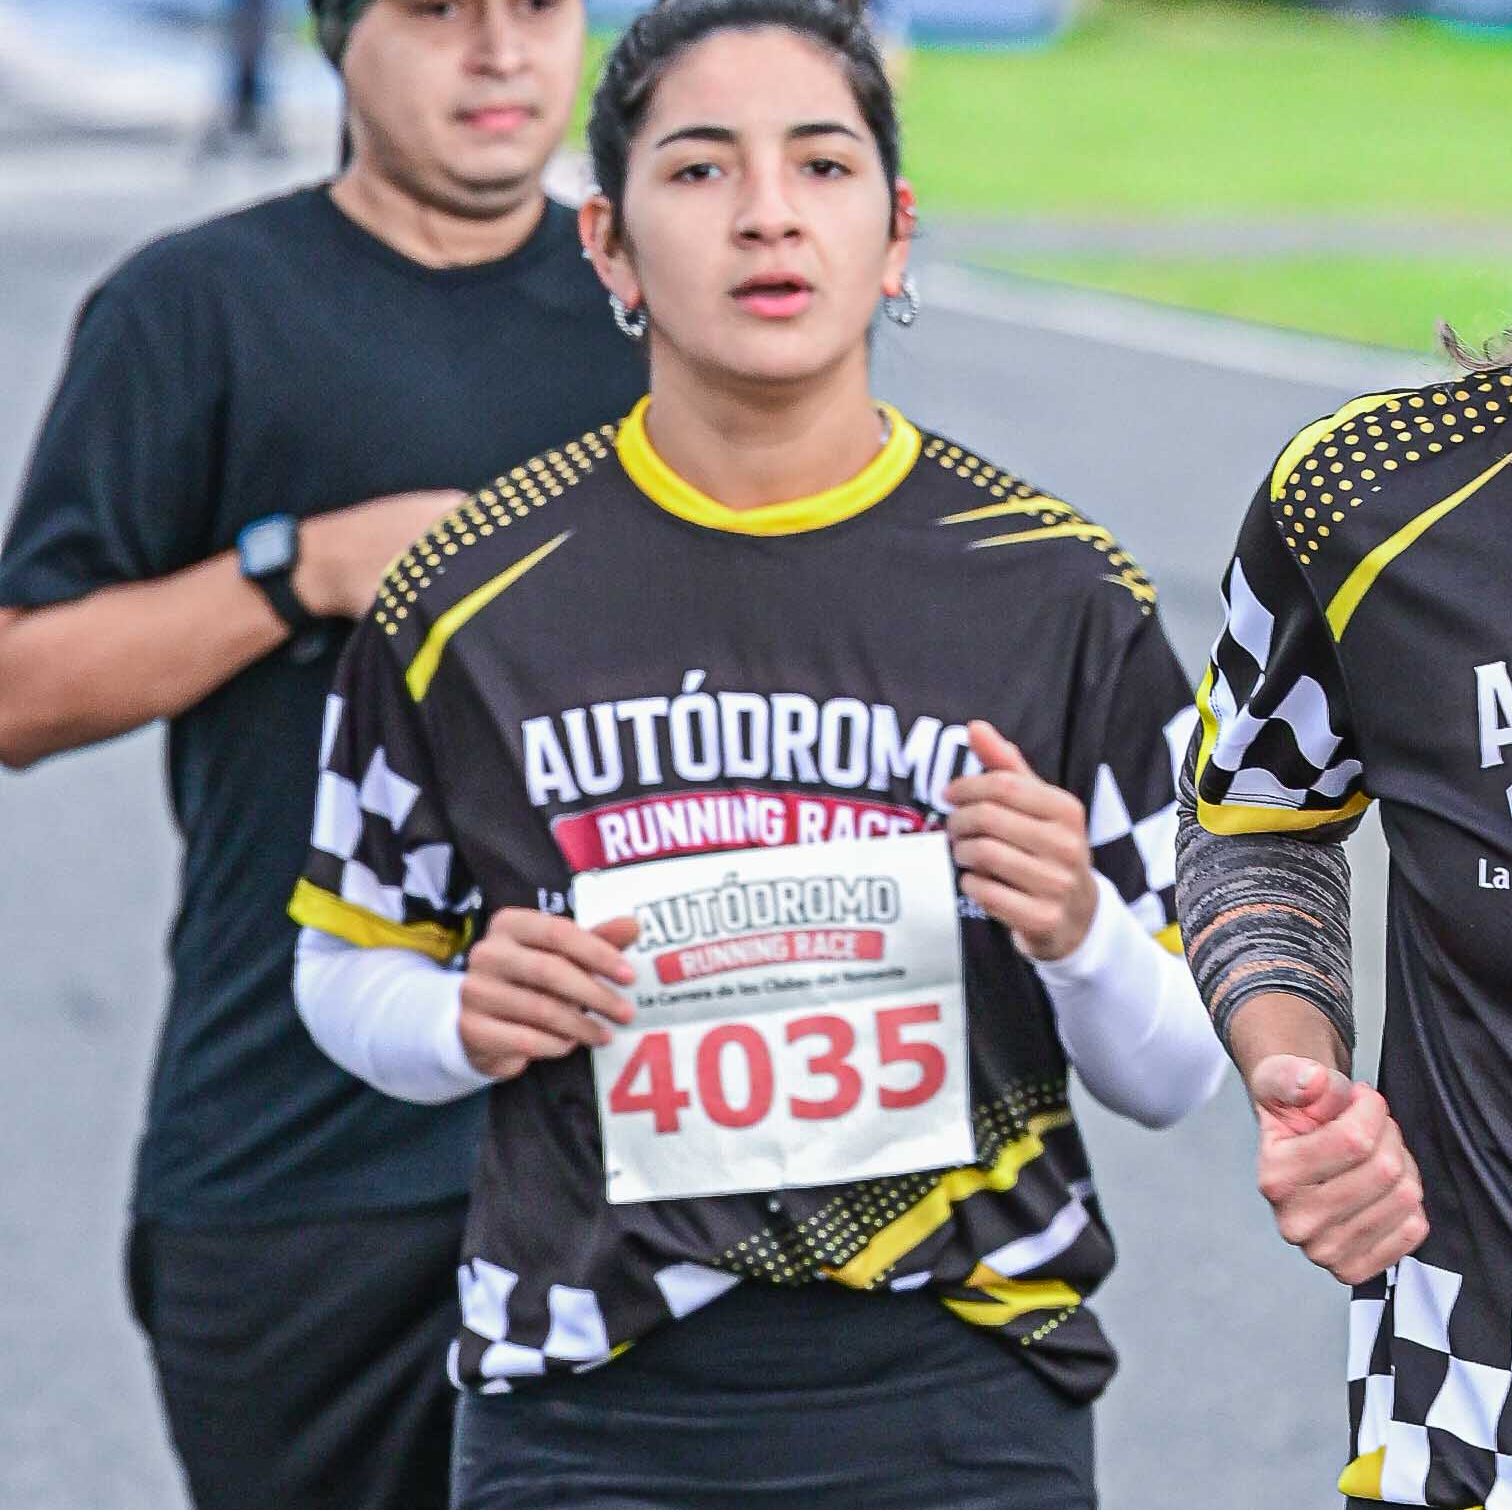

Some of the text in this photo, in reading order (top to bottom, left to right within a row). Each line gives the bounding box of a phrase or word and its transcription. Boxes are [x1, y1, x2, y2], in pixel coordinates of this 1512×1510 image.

[598, 794, 786, 862] RUNNING
[1478, 858, 1511, 889] La
[635, 871, 900, 952] AUTÓDROMO
[679, 931, 859, 979] RUNNING RACE
[608, 1002, 949, 1135] 4035
